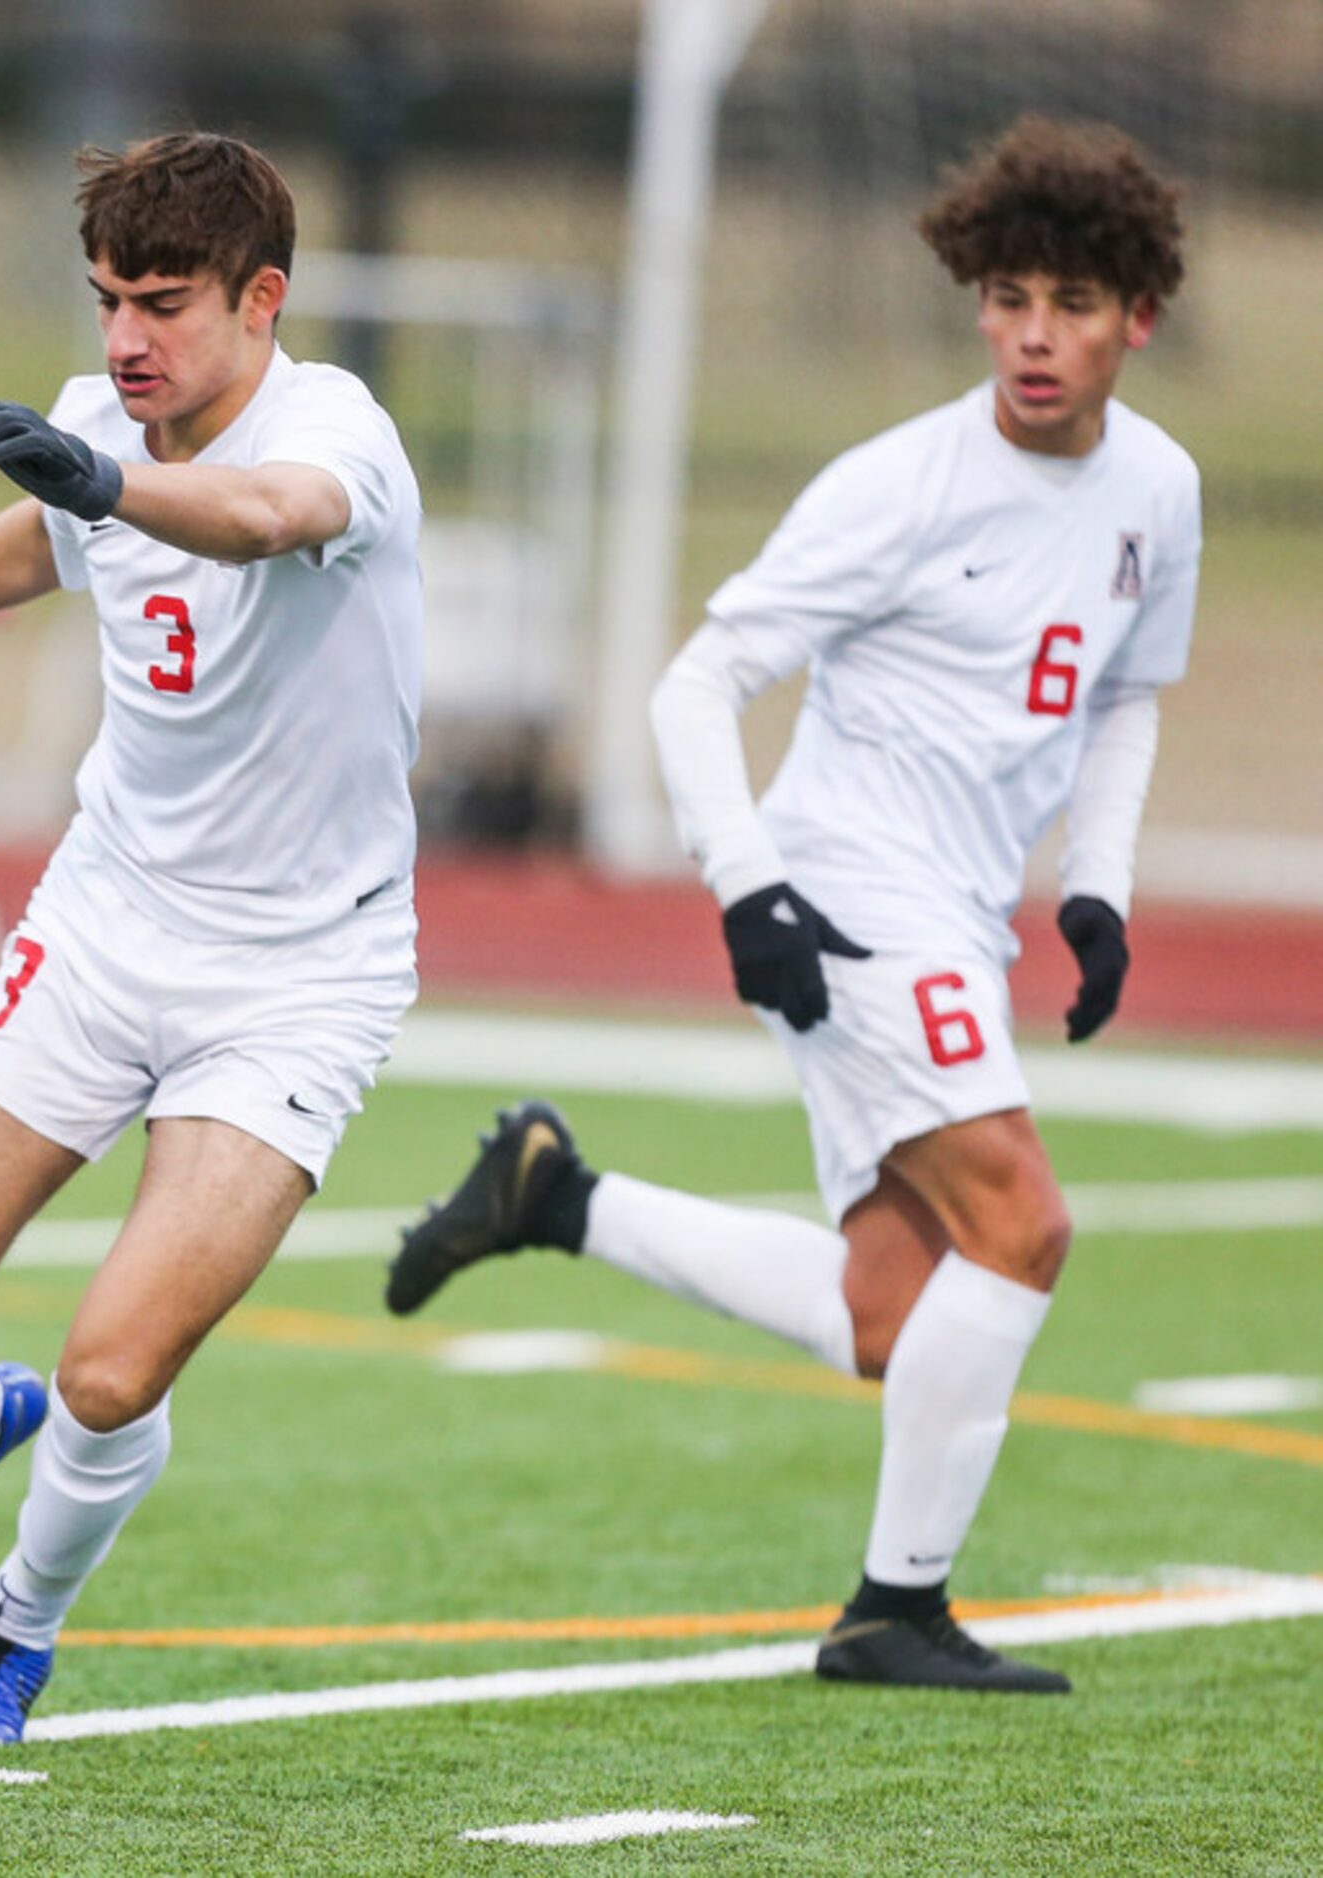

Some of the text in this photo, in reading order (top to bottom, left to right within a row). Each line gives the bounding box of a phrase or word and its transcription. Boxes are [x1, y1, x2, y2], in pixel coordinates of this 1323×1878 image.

[143, 594, 196, 694] 3
[1026, 624, 1083, 720] 6
[912, 972, 986, 1068] 6
